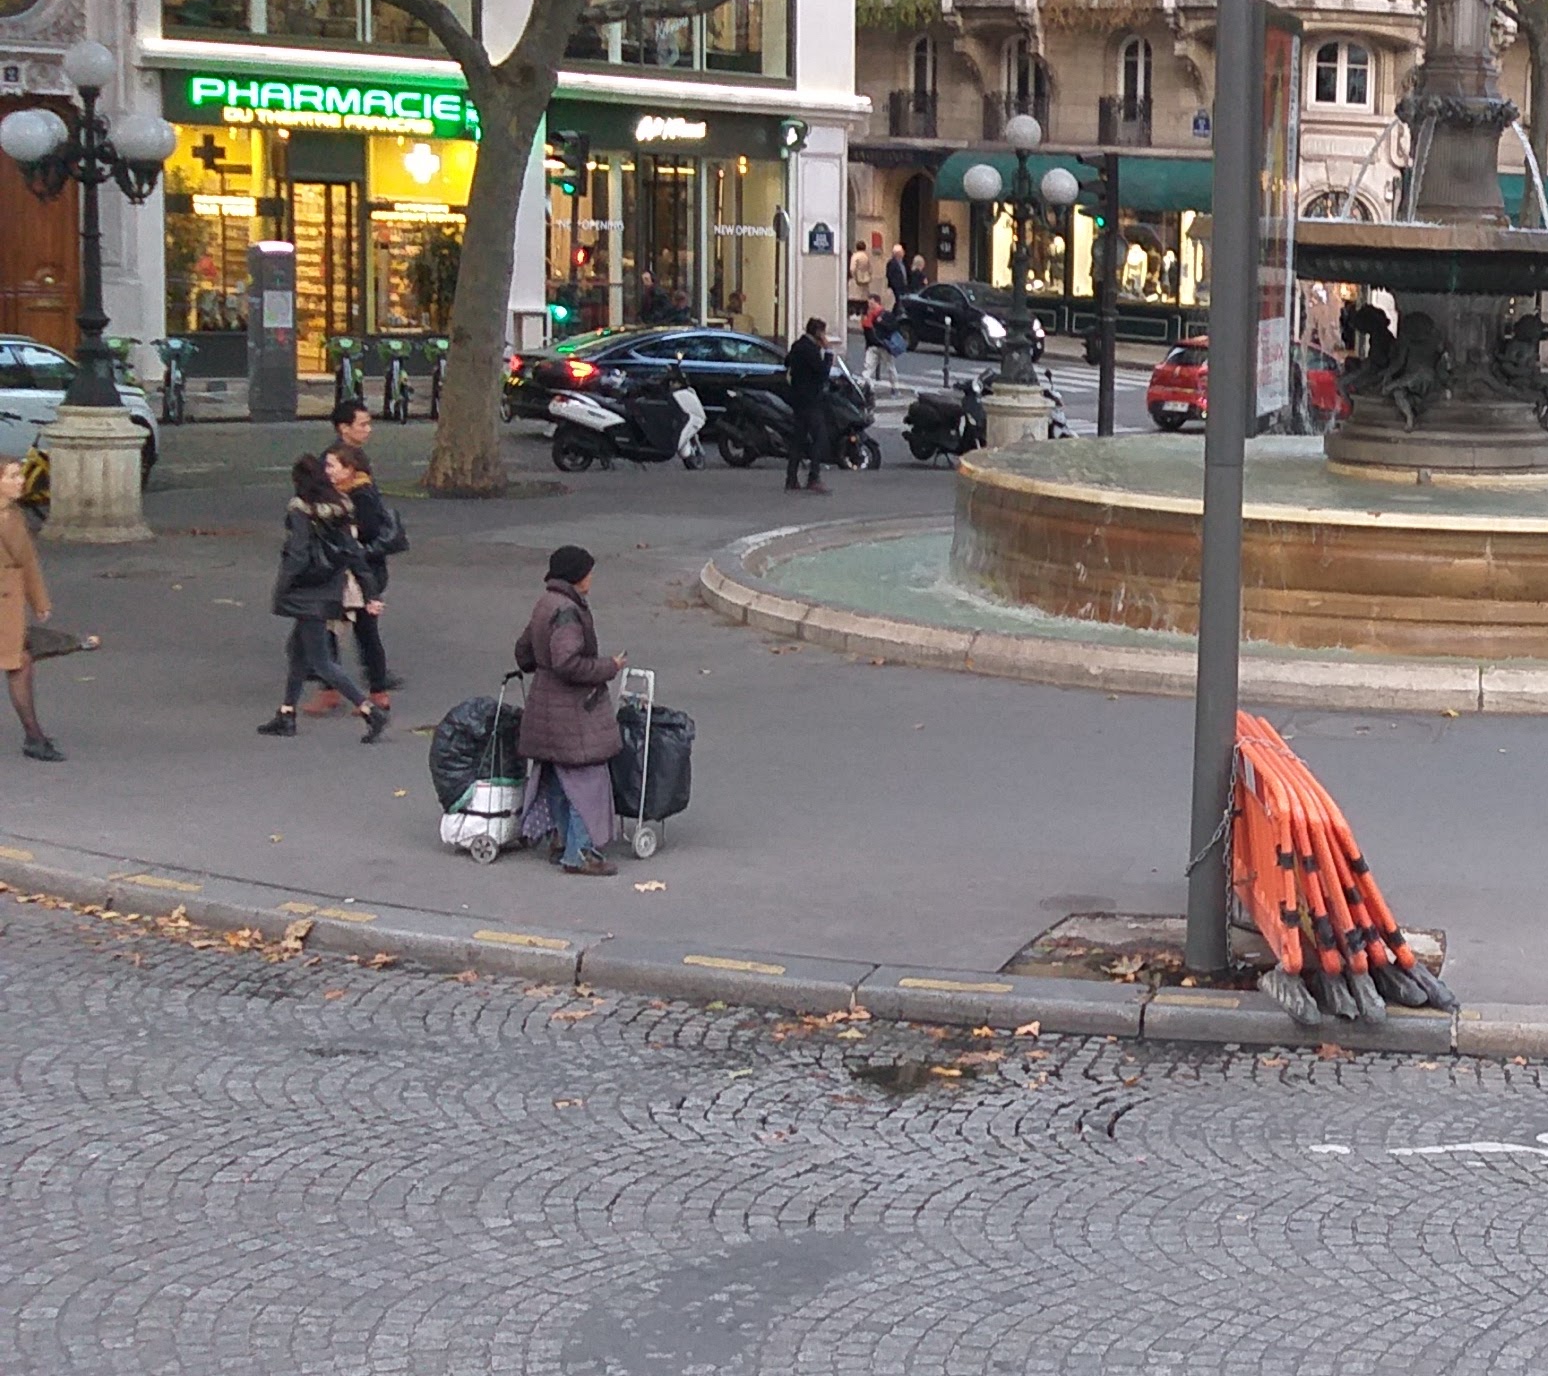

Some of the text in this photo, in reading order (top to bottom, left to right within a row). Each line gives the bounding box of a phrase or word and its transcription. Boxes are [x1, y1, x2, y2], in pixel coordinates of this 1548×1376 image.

[191, 77, 461, 121] PHARMACIE
[223, 107, 253, 123] DU
[714, 225, 734, 236] NEW
